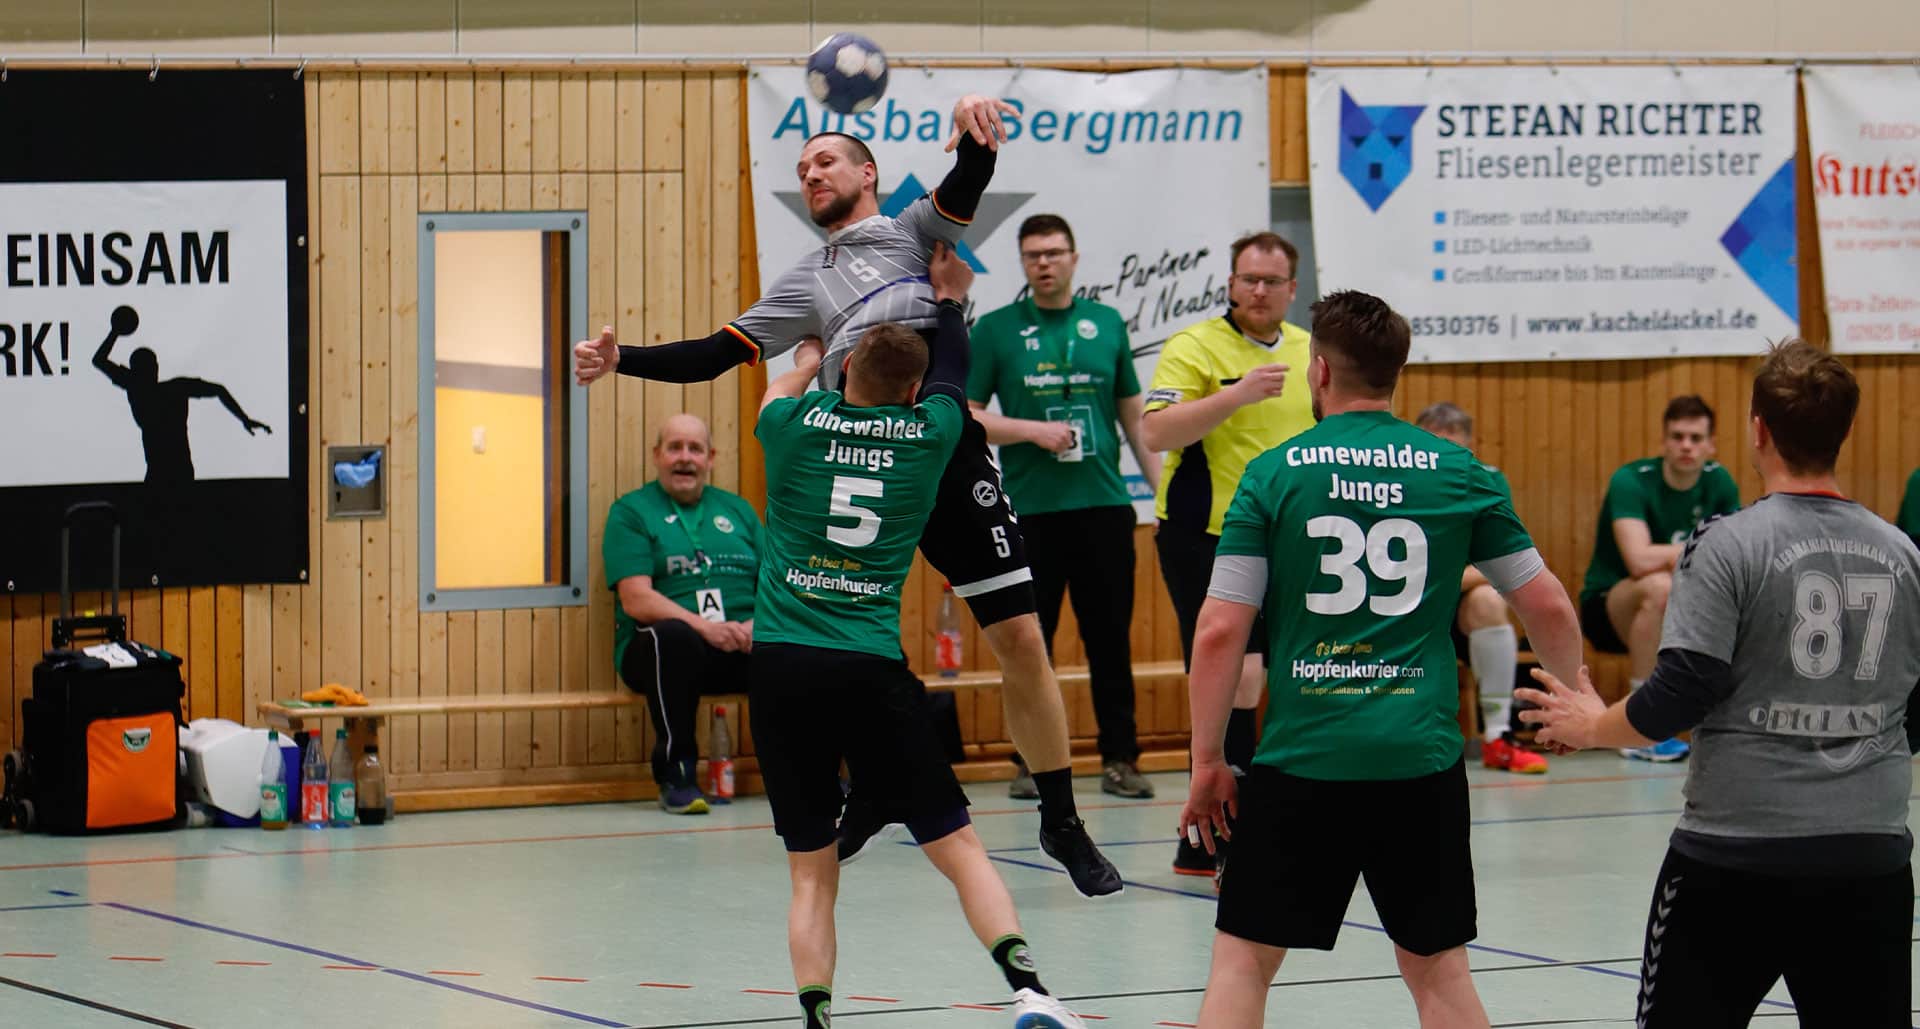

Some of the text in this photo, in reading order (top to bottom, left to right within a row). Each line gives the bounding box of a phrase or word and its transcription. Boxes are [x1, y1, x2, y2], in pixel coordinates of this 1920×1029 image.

[772, 95, 953, 141] Ausba
[1437, 103, 1763, 137] STEFAN RICHTER
[1435, 146, 1761, 187] Fliesenlegermeister
[1520, 208, 1551, 226] und
[7, 231, 230, 287] EINSAM
[847, 257, 881, 283] 5
[803, 406, 925, 439] Cunewalder
[825, 439, 894, 471] Jungs
[1286, 444, 1439, 470] Cunewalder
[1329, 473, 1403, 508] Jungs
[826, 475, 884, 547] 5
[991, 525, 1011, 558] 5
[1306, 515, 1429, 616] 39
[703, 592, 720, 613] A
[1790, 570, 1896, 681] 87
